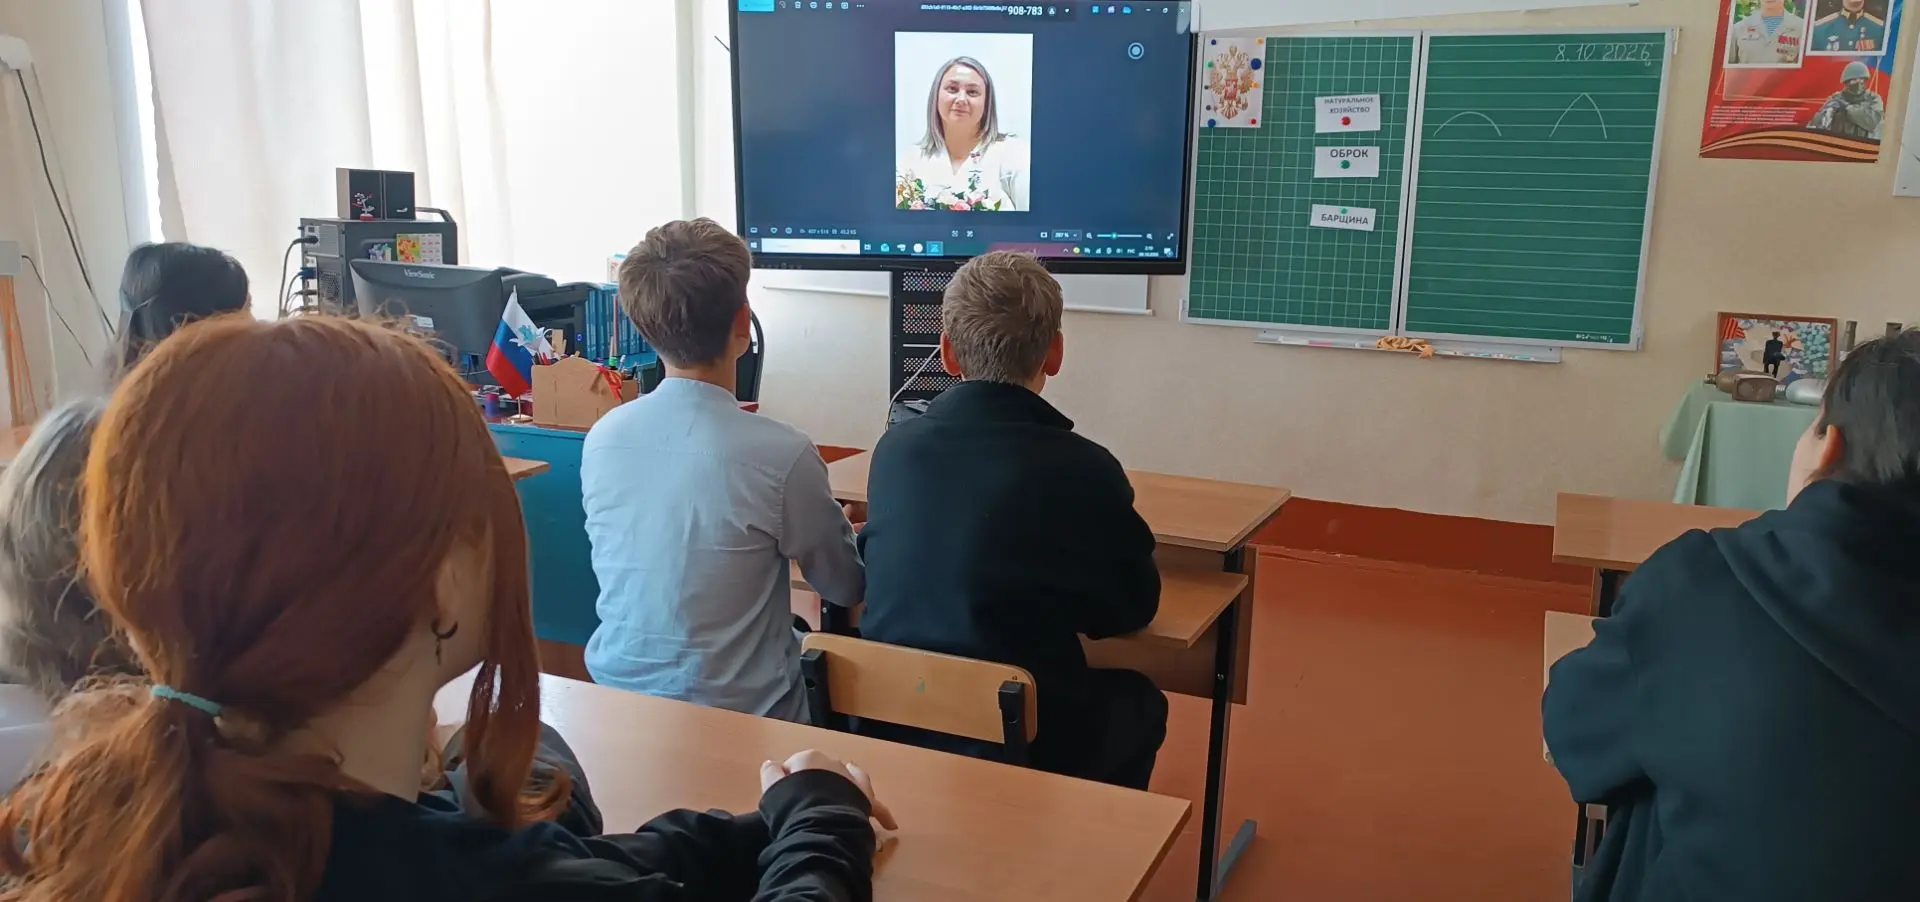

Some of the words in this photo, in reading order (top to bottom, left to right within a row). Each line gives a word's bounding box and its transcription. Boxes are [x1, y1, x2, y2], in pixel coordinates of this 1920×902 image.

[1007, 5, 1043, 16] 908-783
[1324, 96, 1374, 104] НАТУРАЛЬНОЕ
[1328, 105, 1370, 114] ХОЗЯЙСТВО
[1330, 148, 1369, 159] ОБРОК
[1321, 213, 1369, 225] БАРЩИНА
[403, 268, 436, 280] ViewSonic
